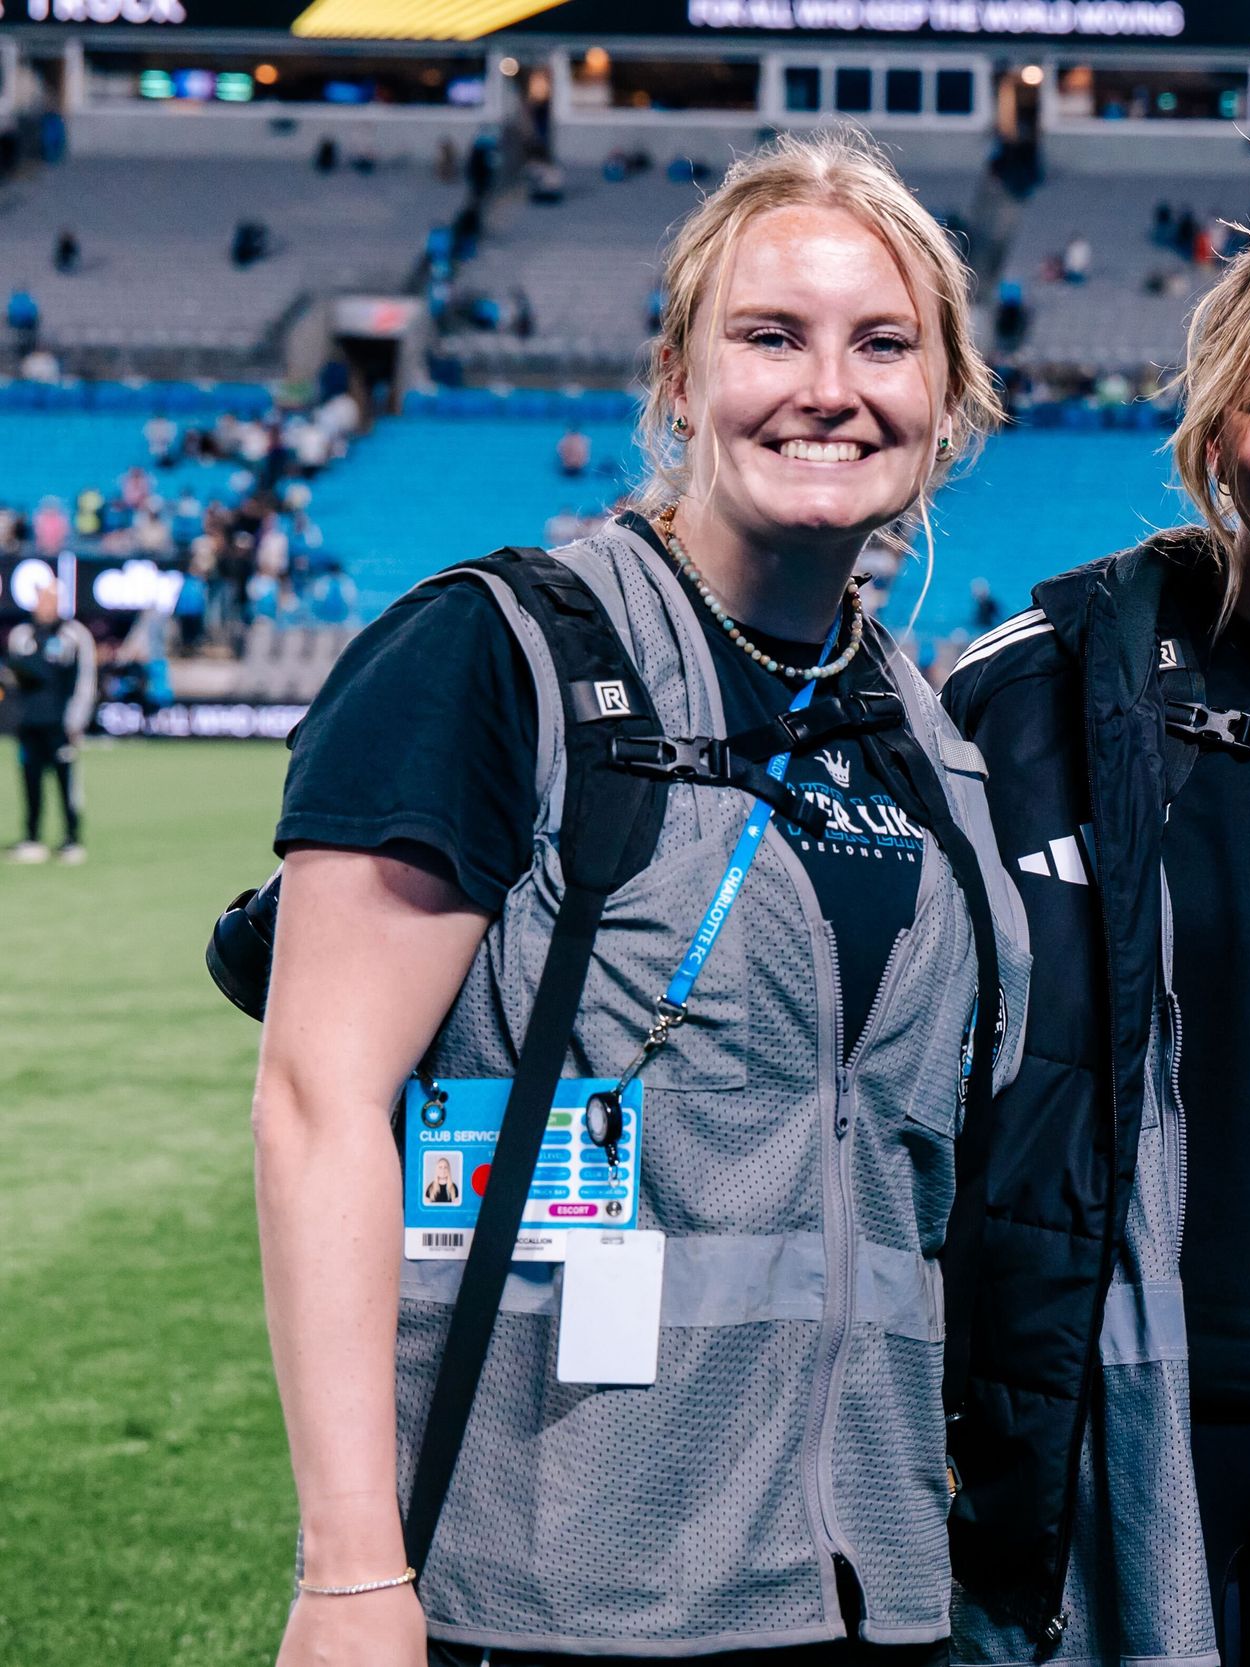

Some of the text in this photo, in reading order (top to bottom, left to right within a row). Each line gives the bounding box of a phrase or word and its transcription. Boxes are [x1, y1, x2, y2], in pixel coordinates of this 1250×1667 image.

[981, 0, 1076, 34] WORLD
[1076, 0, 1185, 36] MOVING
[856, 804, 924, 839] LIK
[801, 841, 915, 863] BELONG IN
[689, 866, 743, 965] CHARLOTTE FC
[419, 1130, 451, 1142] CLUB
[557, 1206, 590, 1214] ESCORT
